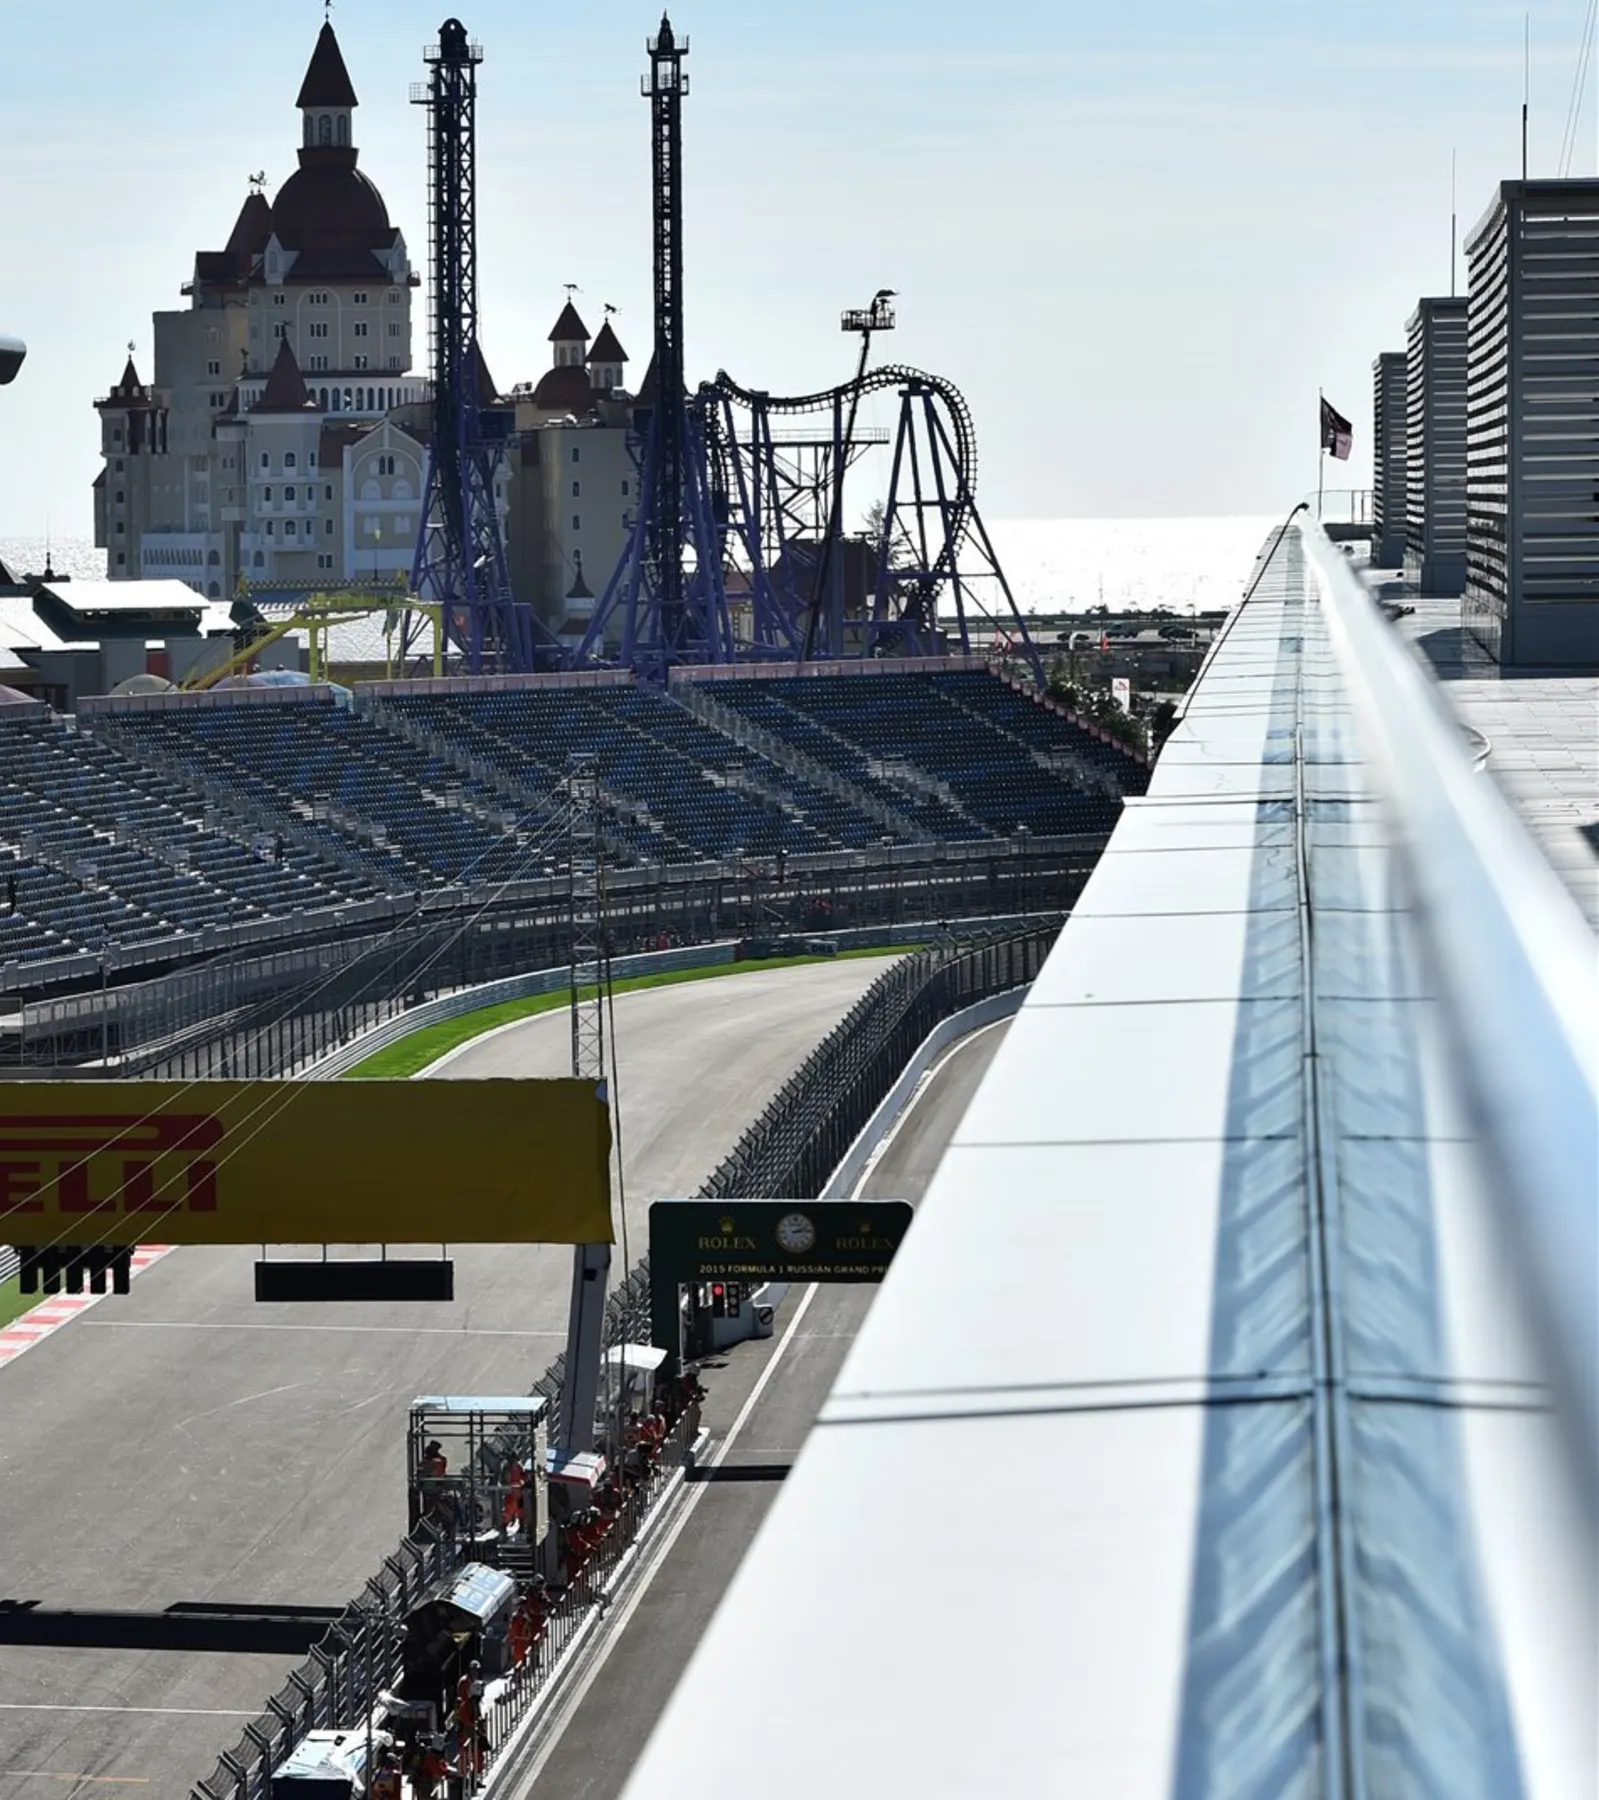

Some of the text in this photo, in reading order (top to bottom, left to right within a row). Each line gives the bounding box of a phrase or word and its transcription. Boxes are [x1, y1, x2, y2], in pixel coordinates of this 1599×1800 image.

[699, 1236, 757, 1250] ROLEX
[836, 1236, 895, 1250] ROLEX
[699, 1264, 726, 1274] 2015
[727, 1264, 776, 1274] FORMULA
[779, 1264, 785, 1274] 1
[787, 1265, 832, 1274] RUSSIAN
[833, 1265, 870, 1275] GRAND
